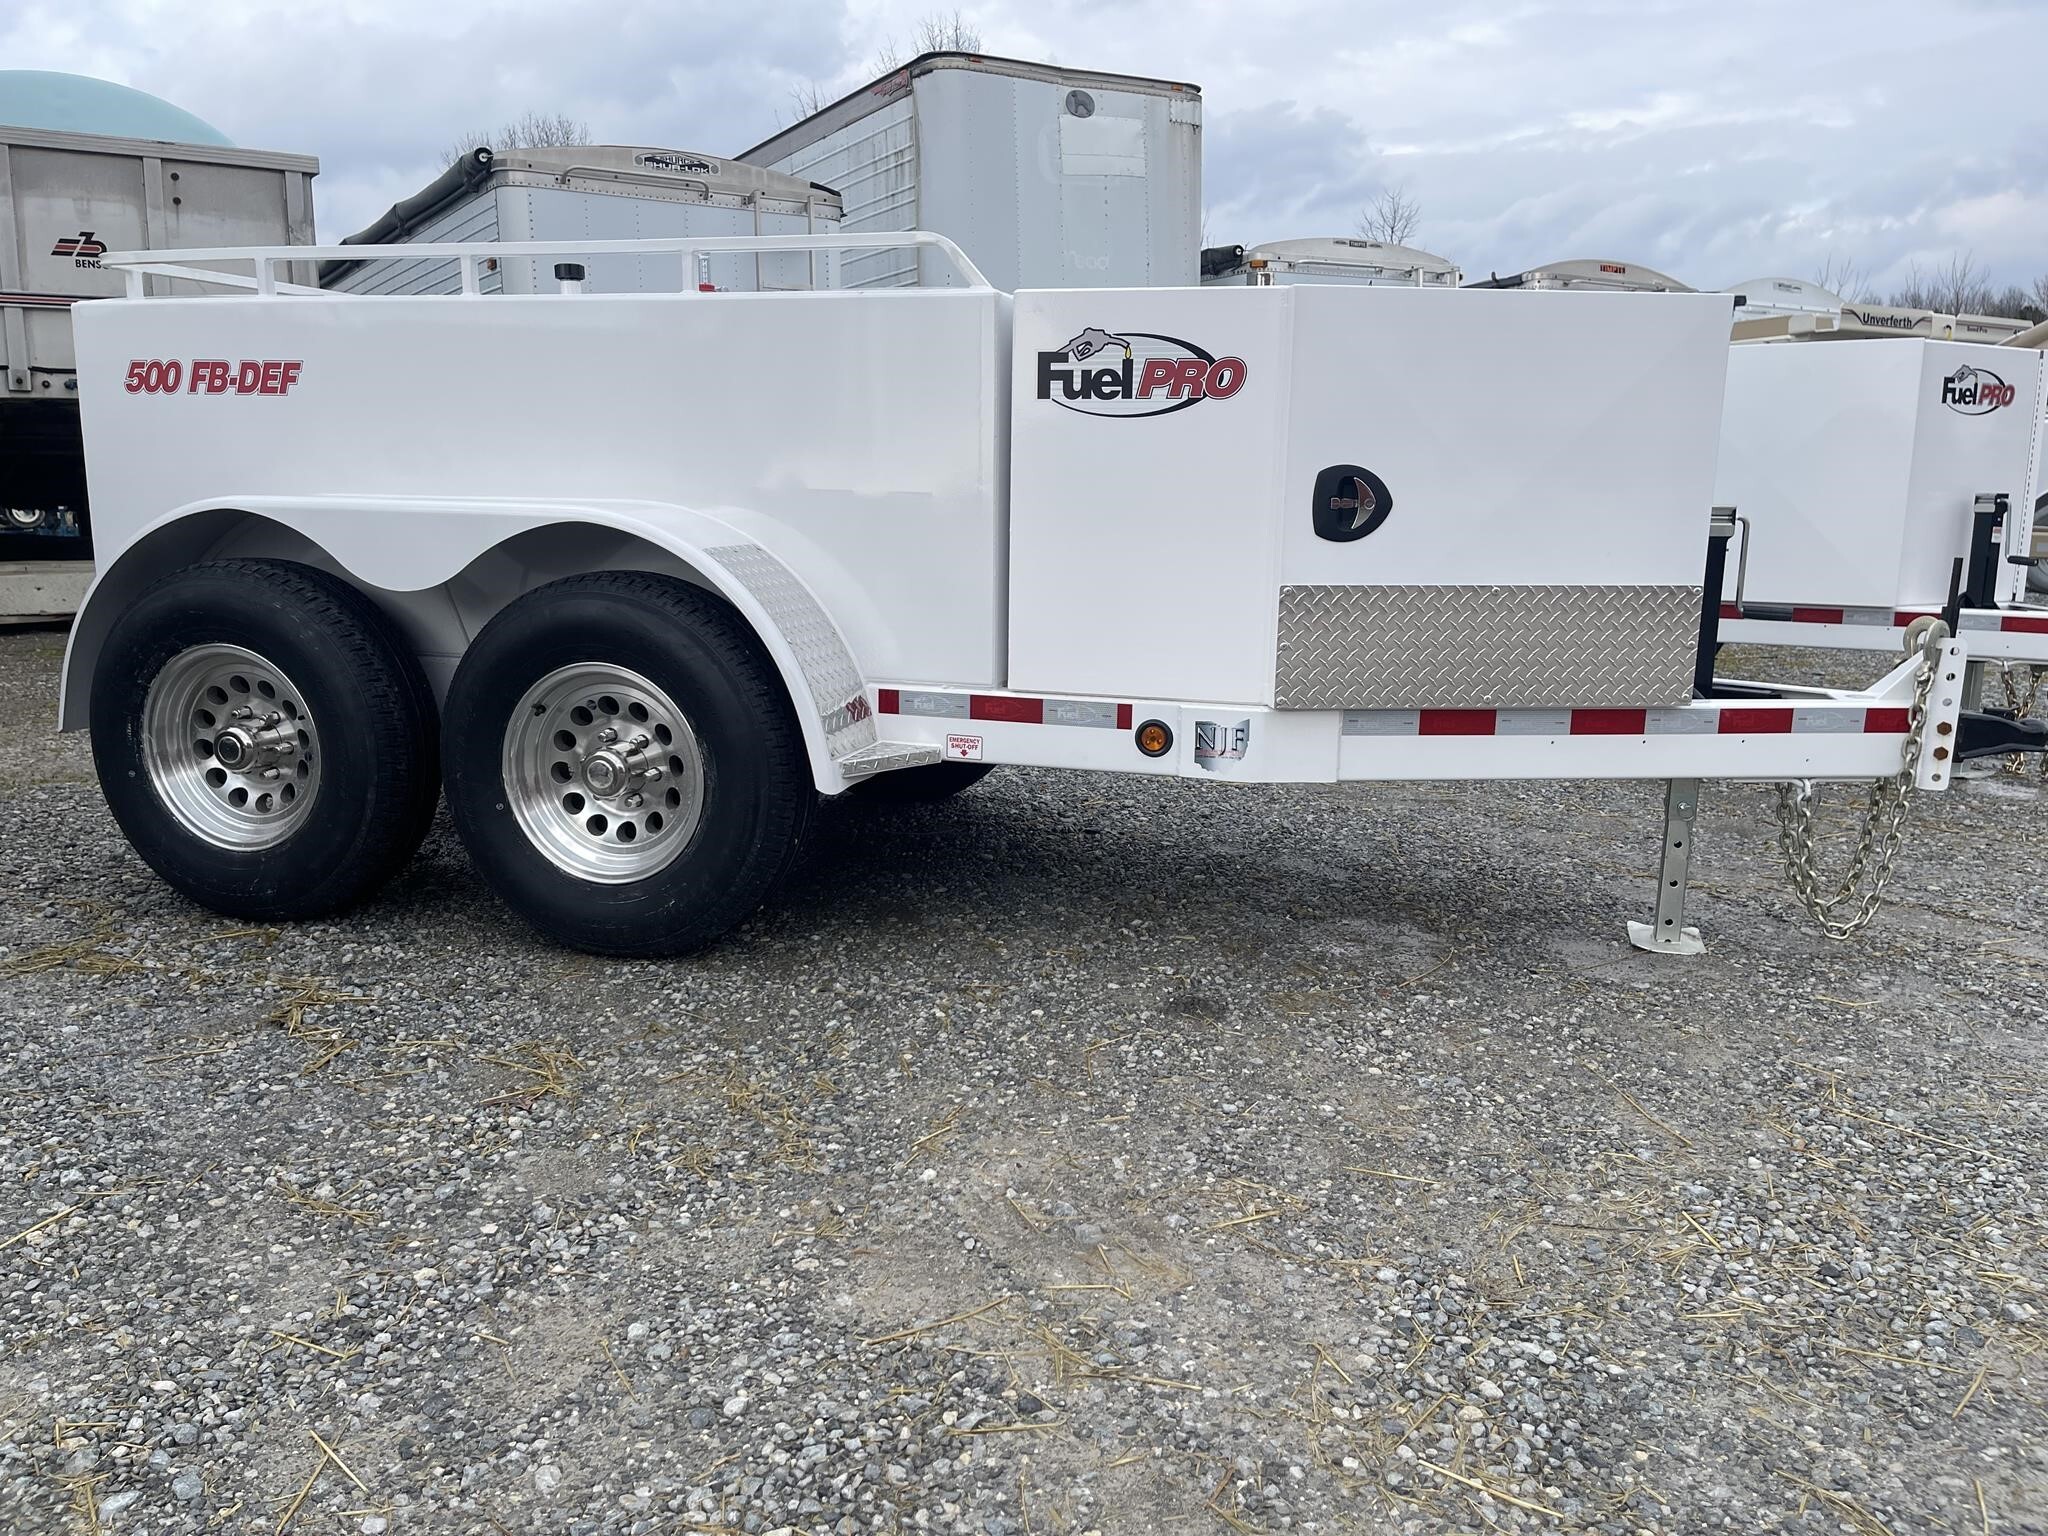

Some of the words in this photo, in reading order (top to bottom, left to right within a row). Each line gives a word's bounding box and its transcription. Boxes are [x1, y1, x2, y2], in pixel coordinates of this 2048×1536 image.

[75, 259, 107, 270] BENS
[1863, 312, 1913, 329] Unverferth
[124, 359, 183, 395] 500
[187, 359, 303, 396] FB-DEF
[949, 736, 981, 745] EMERGENCY
[951, 743, 979, 751] SHUT-OFF
[1195, 726, 1245, 757] NJF
